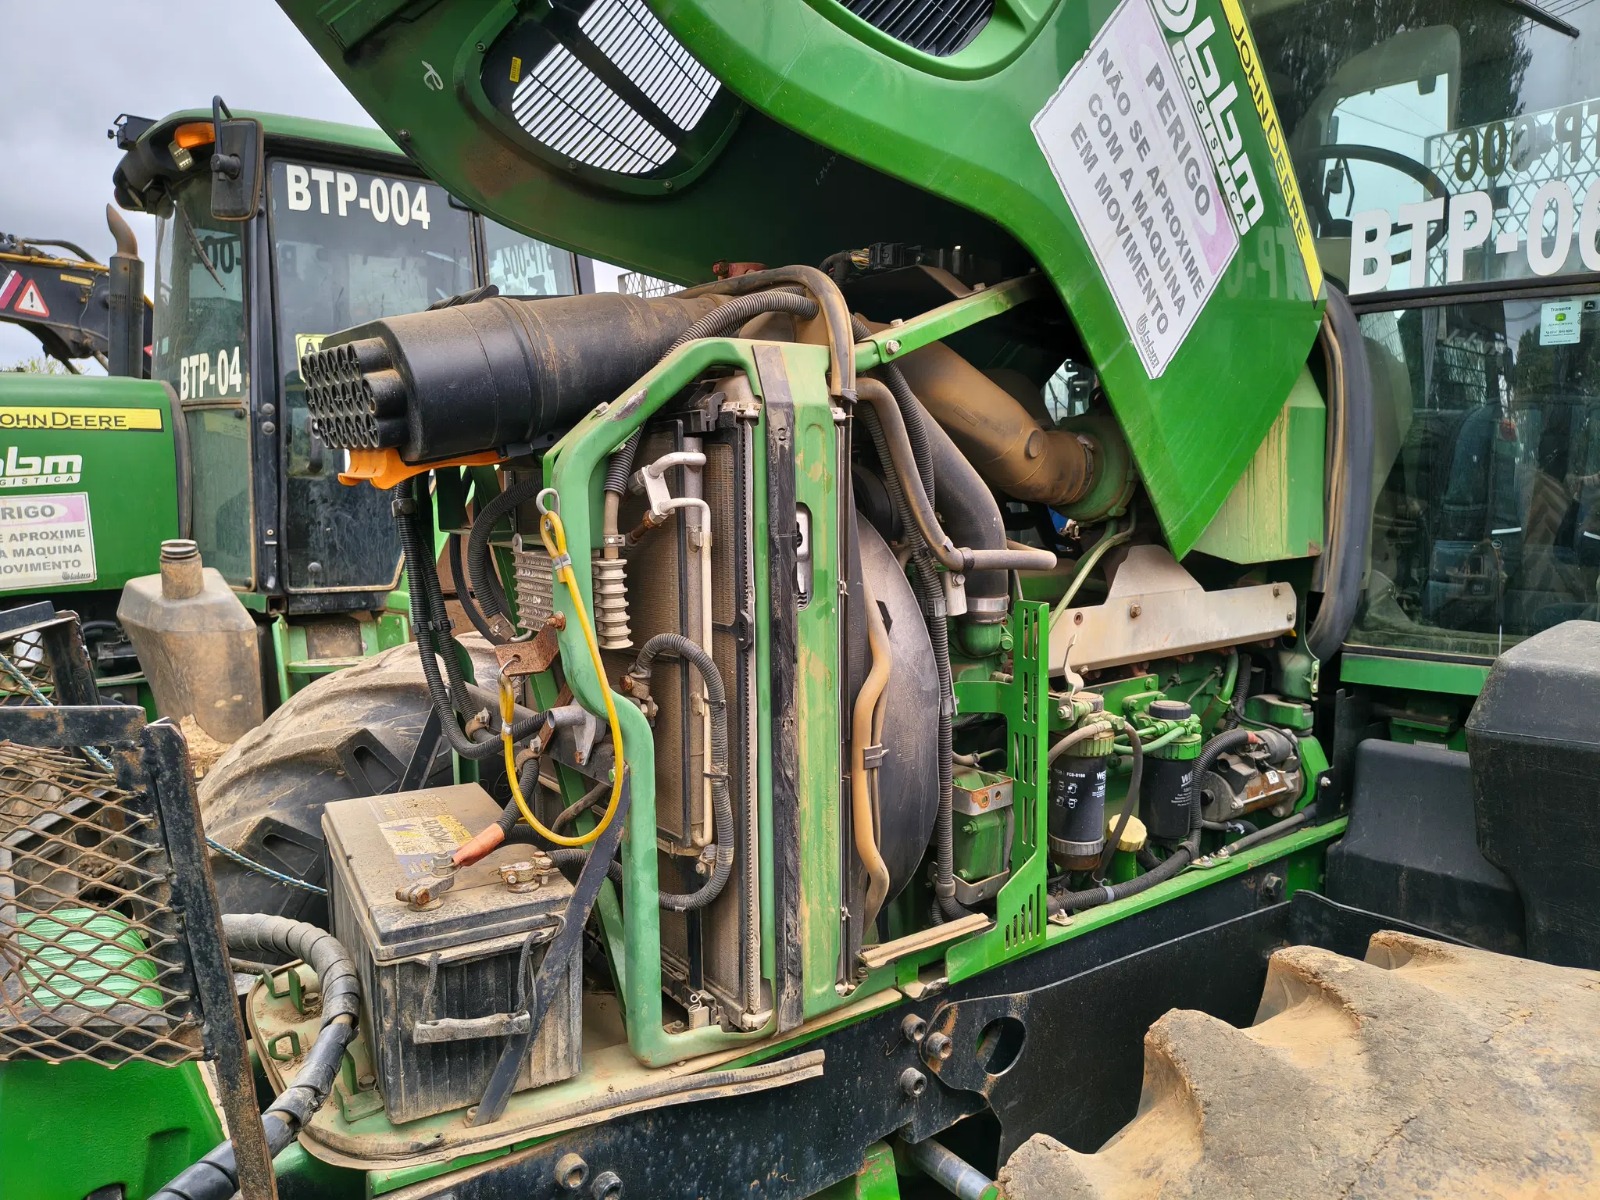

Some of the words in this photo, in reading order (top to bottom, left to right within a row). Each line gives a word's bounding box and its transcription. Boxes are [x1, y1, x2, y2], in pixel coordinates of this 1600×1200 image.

[1145, 62, 1210, 216] PERIGO
[1232, 24, 1270, 122] JOHN
[1265, 120, 1306, 243] DEERE
[286, 164, 431, 230] BTP-004
[1096, 47, 1131, 116] NÃO
[1129, 119, 1151, 163] SE
[1146, 165, 1205, 299] APROXIME
[1070, 122, 1099, 174] EM
[1094, 172, 1169, 334] MOVIMENTO
[1088, 93, 1125, 164] COM
[1119, 167, 1134, 192] A
[1131, 189, 1186, 317] MAQUINA
[180, 346, 242, 400] BTP-04
[52, 411, 127, 427] DEERE
[0, 446, 83, 477] bm
[9, 529, 86, 542] APROXIME
[12, 544, 83, 558] MAQUINA
[0, 559, 82, 575] OVIMENTO
